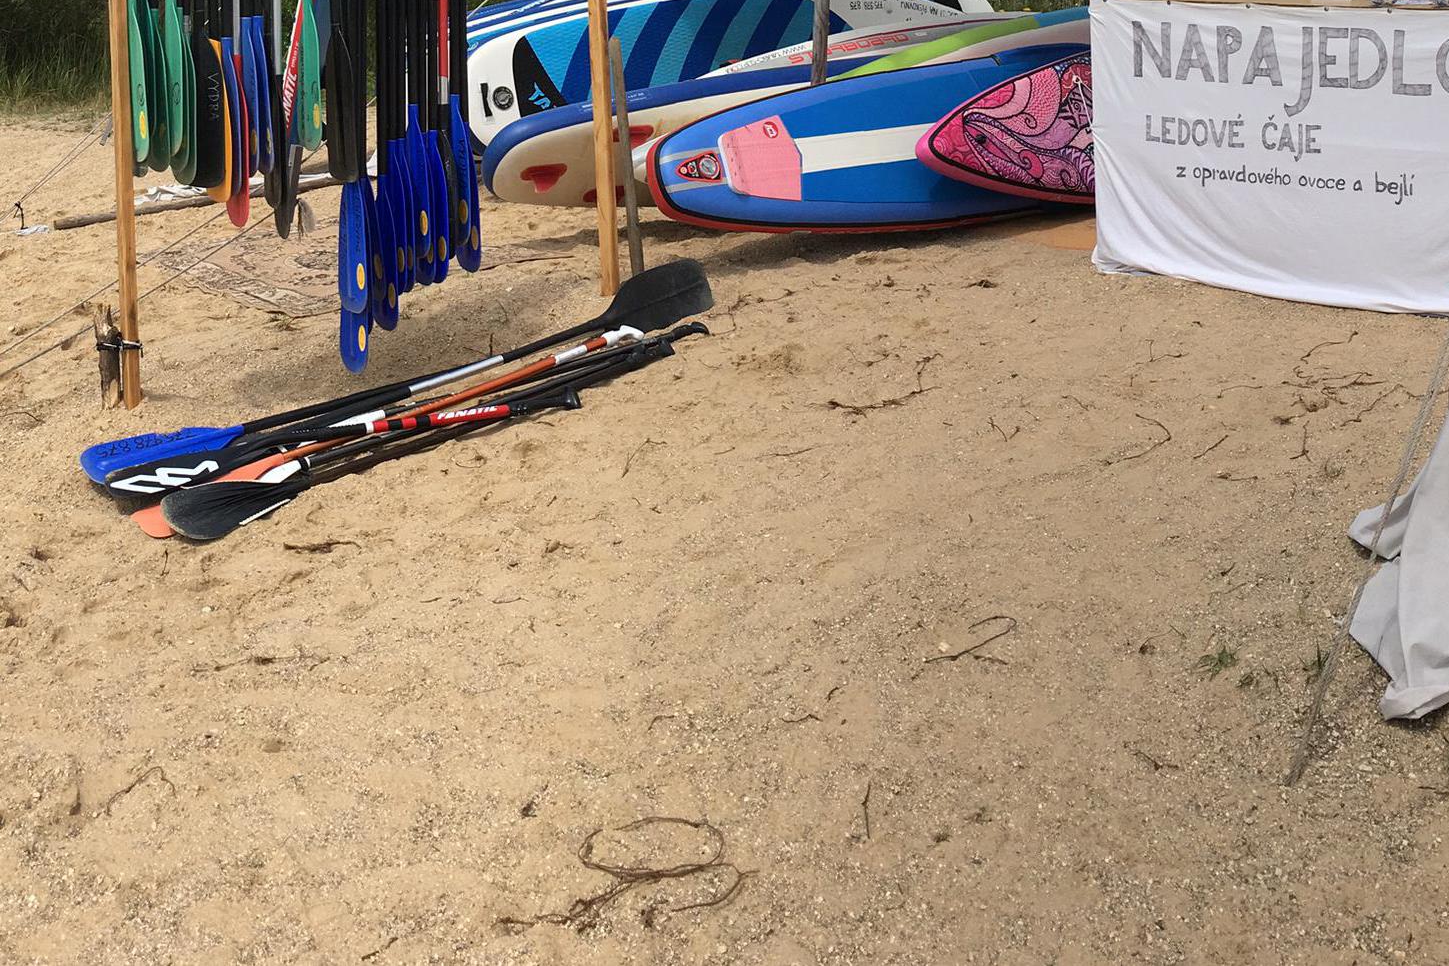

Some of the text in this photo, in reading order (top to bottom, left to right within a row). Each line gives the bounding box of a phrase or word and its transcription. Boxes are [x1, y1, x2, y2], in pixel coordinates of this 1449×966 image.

[789, 33, 910, 65] STRBOARD
[1145, 113, 1322, 163] LEDOVÉ ČAJE
[1176, 164, 1415, 206] z opravdového ovoce a bejlí
